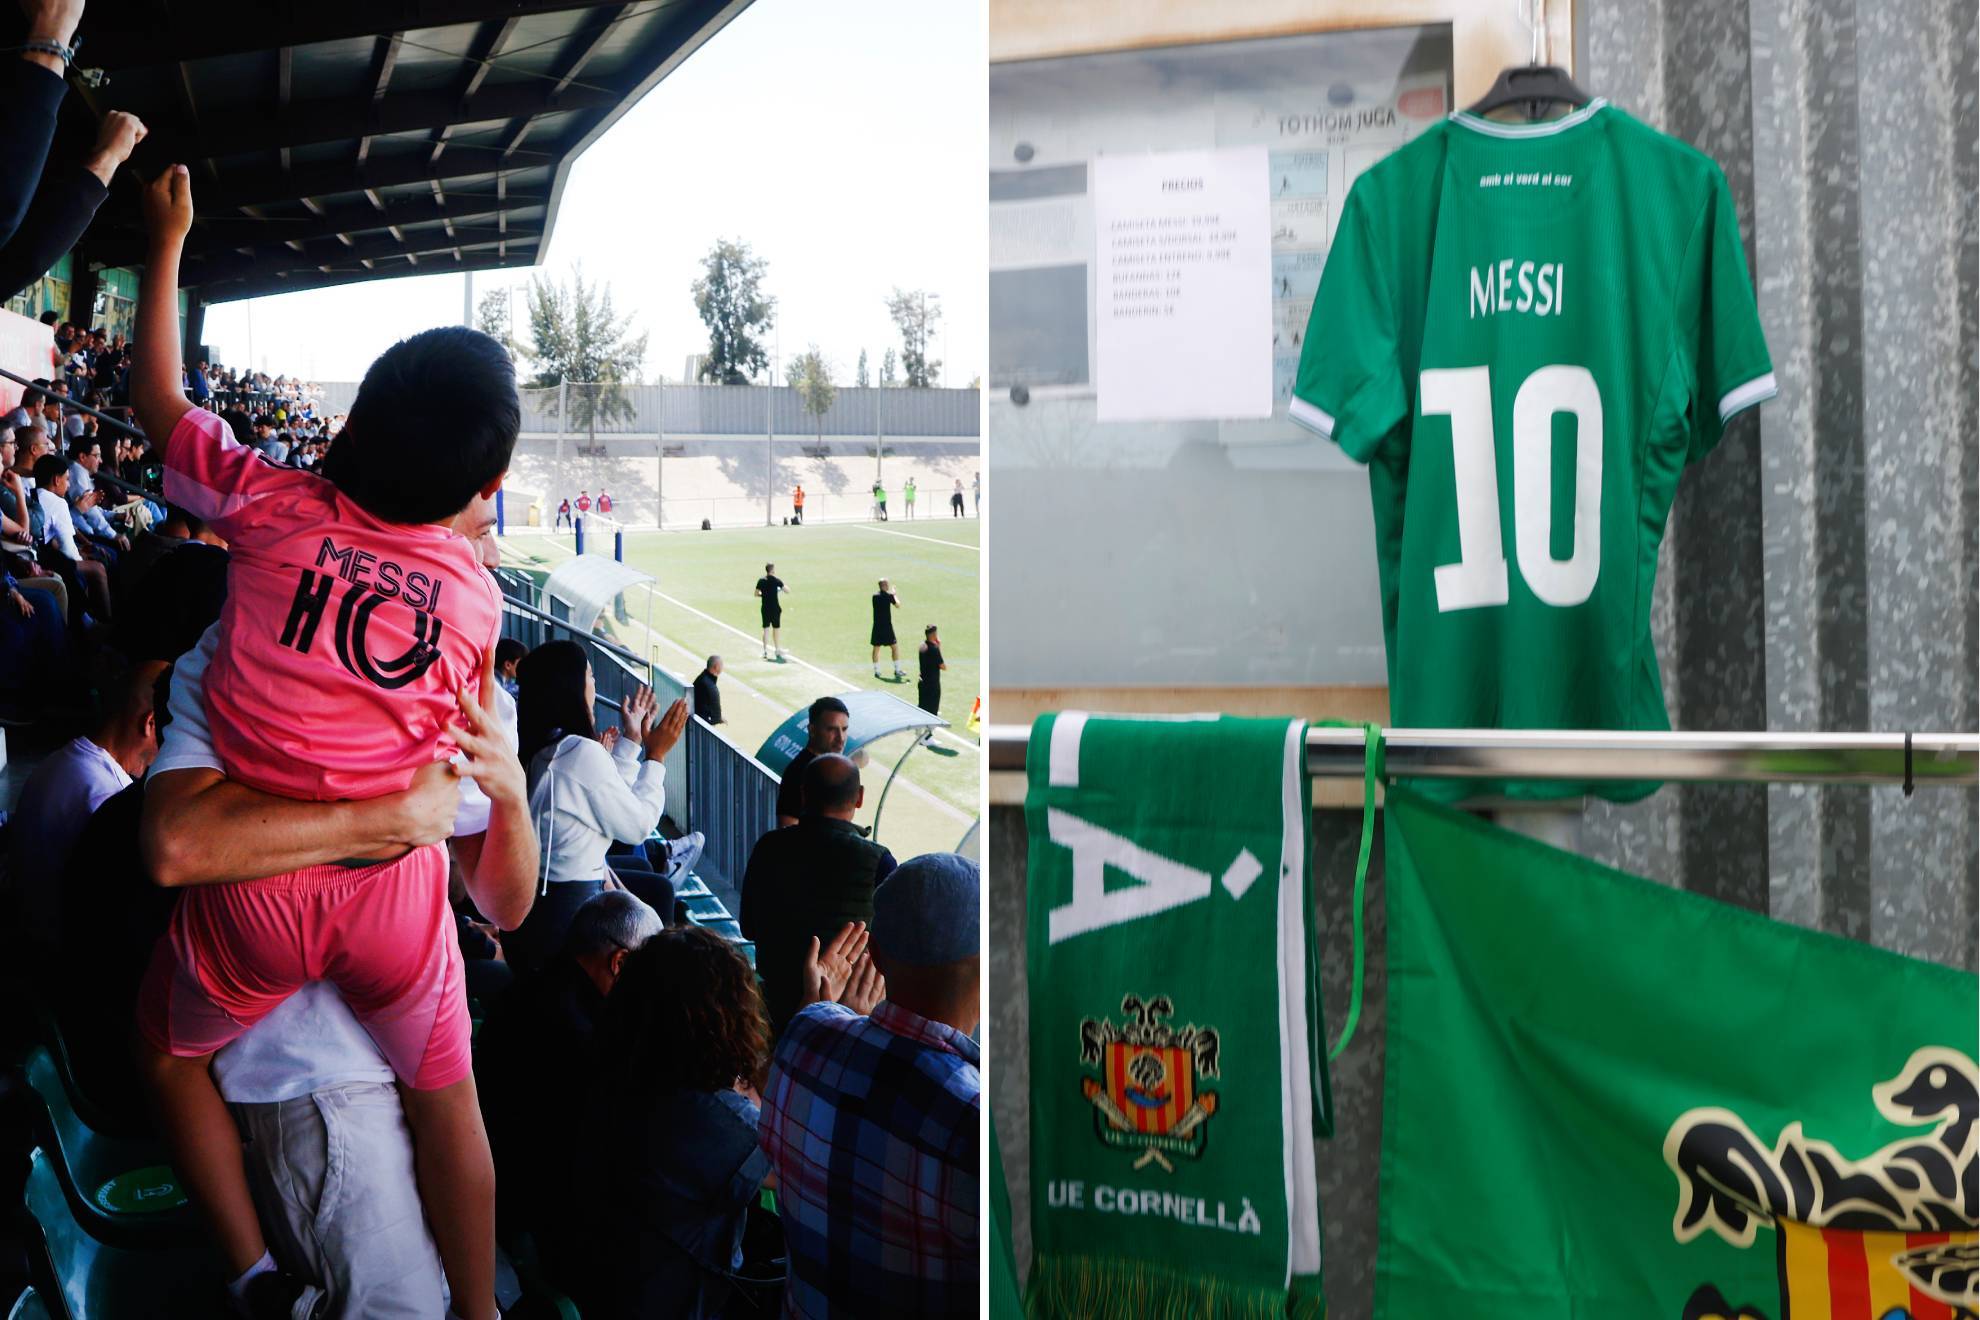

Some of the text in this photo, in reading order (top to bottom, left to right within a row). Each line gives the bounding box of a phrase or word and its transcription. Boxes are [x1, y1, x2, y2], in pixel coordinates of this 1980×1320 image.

[1279, 108, 1397, 136] TOTHOM JUGA
[1161, 176, 1204, 192] PRECIOS
[1111, 217, 1156, 231] CAMISETA
[1111, 234, 1156, 248] CAMISETA
[1111, 251, 1156, 265] CAMISETA
[1469, 258, 1564, 320] MESSI
[1420, 364, 1604, 613] 10
[315, 536, 442, 614] MESSI
[1048, 1179, 1261, 1236] UE CORNELLÀ
